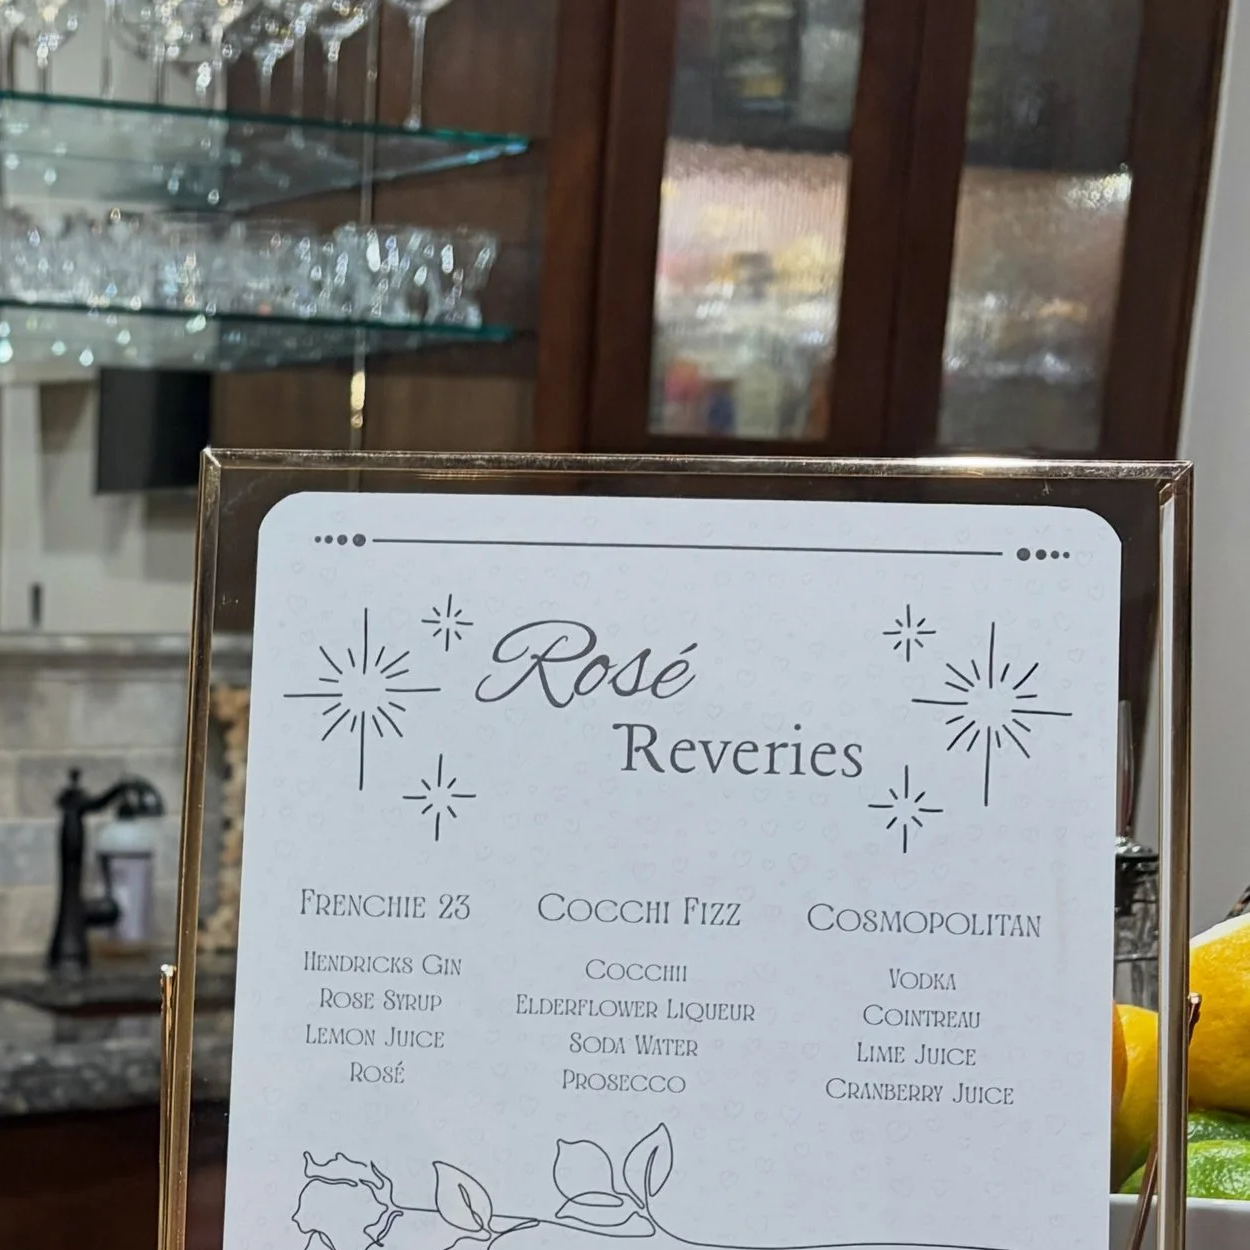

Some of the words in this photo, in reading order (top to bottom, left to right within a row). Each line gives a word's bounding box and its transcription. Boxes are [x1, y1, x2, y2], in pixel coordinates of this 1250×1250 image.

[475, 619, 698, 709] Rosé
[612, 722, 864, 778] Reveries
[300, 888, 426, 919] FRENCHIE
[438, 893, 471, 920] 23
[537, 892, 670, 925] COCCHI
[683, 896, 742, 927] FIZZ
[807, 902, 1042, 938] COSMOPOLITAN
[303, 950, 414, 974] HENDRICKS
[421, 953, 462, 976] GIN
[888, 967, 957, 991] VODKA
[319, 987, 375, 1010] ROSE
[383, 989, 443, 1012] SYRUP
[515, 993, 658, 1019] ELDERFLOWER
[666, 998, 756, 1023] LIQUEUR
[862, 1003, 981, 1029] COINTREAU
[305, 1023, 376, 1047] LEMON
[384, 1026, 445, 1049] JUICE
[569, 1031, 626, 1055] SODA
[634, 1034, 698, 1057] WATER
[857, 1041, 906, 1064] LIME
[914, 1043, 977, 1066] JUICE
[349, 1060, 405, 1084] ROSÉ
[562, 1068, 687, 1094] PROSECCO
[825, 1077, 944, 1103] CRANBERRY
[952, 1082, 1014, 1105] JUICE
